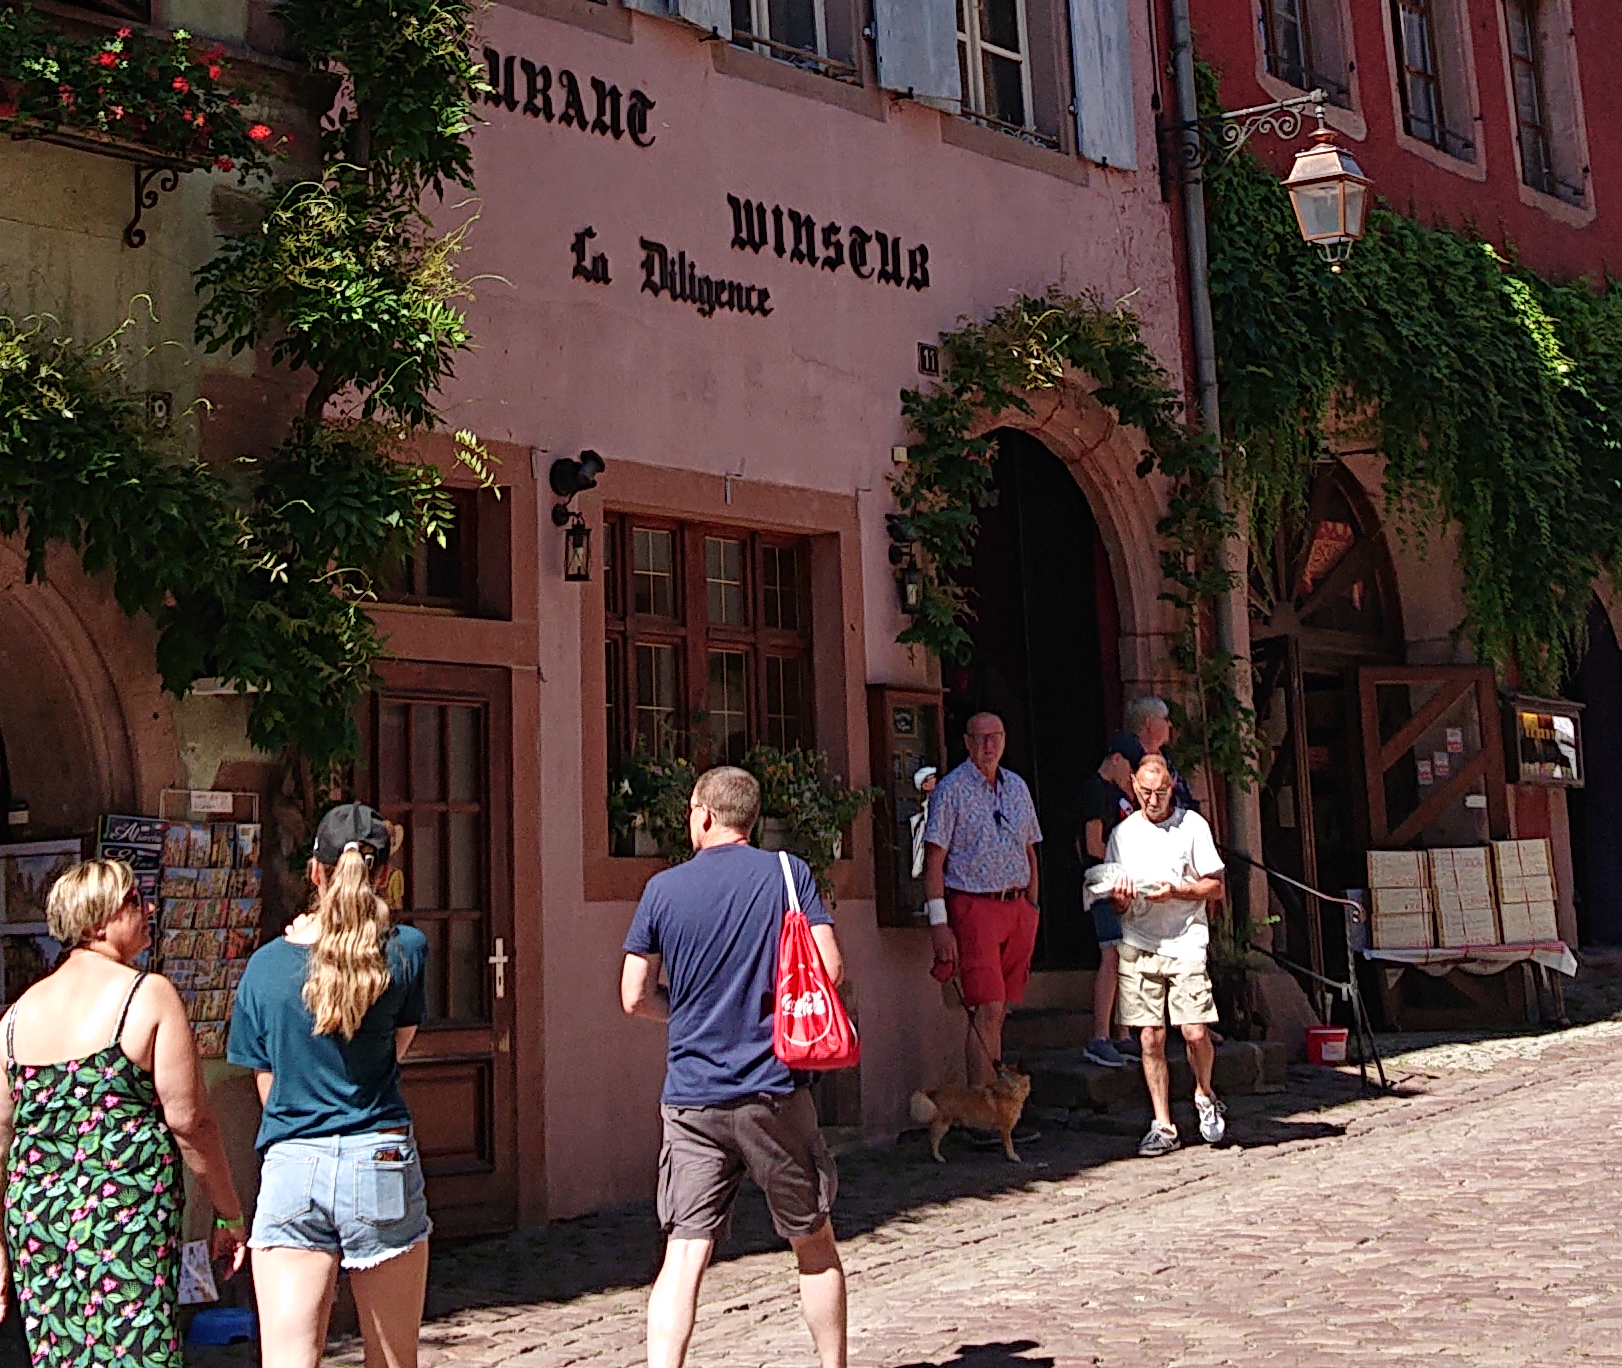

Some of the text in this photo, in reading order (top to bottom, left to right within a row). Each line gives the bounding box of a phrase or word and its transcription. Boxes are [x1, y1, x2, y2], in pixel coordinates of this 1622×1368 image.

[469, 46, 657, 147] URANT
[570, 224, 775, 318] La Diligence
[726, 192, 932, 292] WINSTUB
[923, 348, 935, 371] 11
